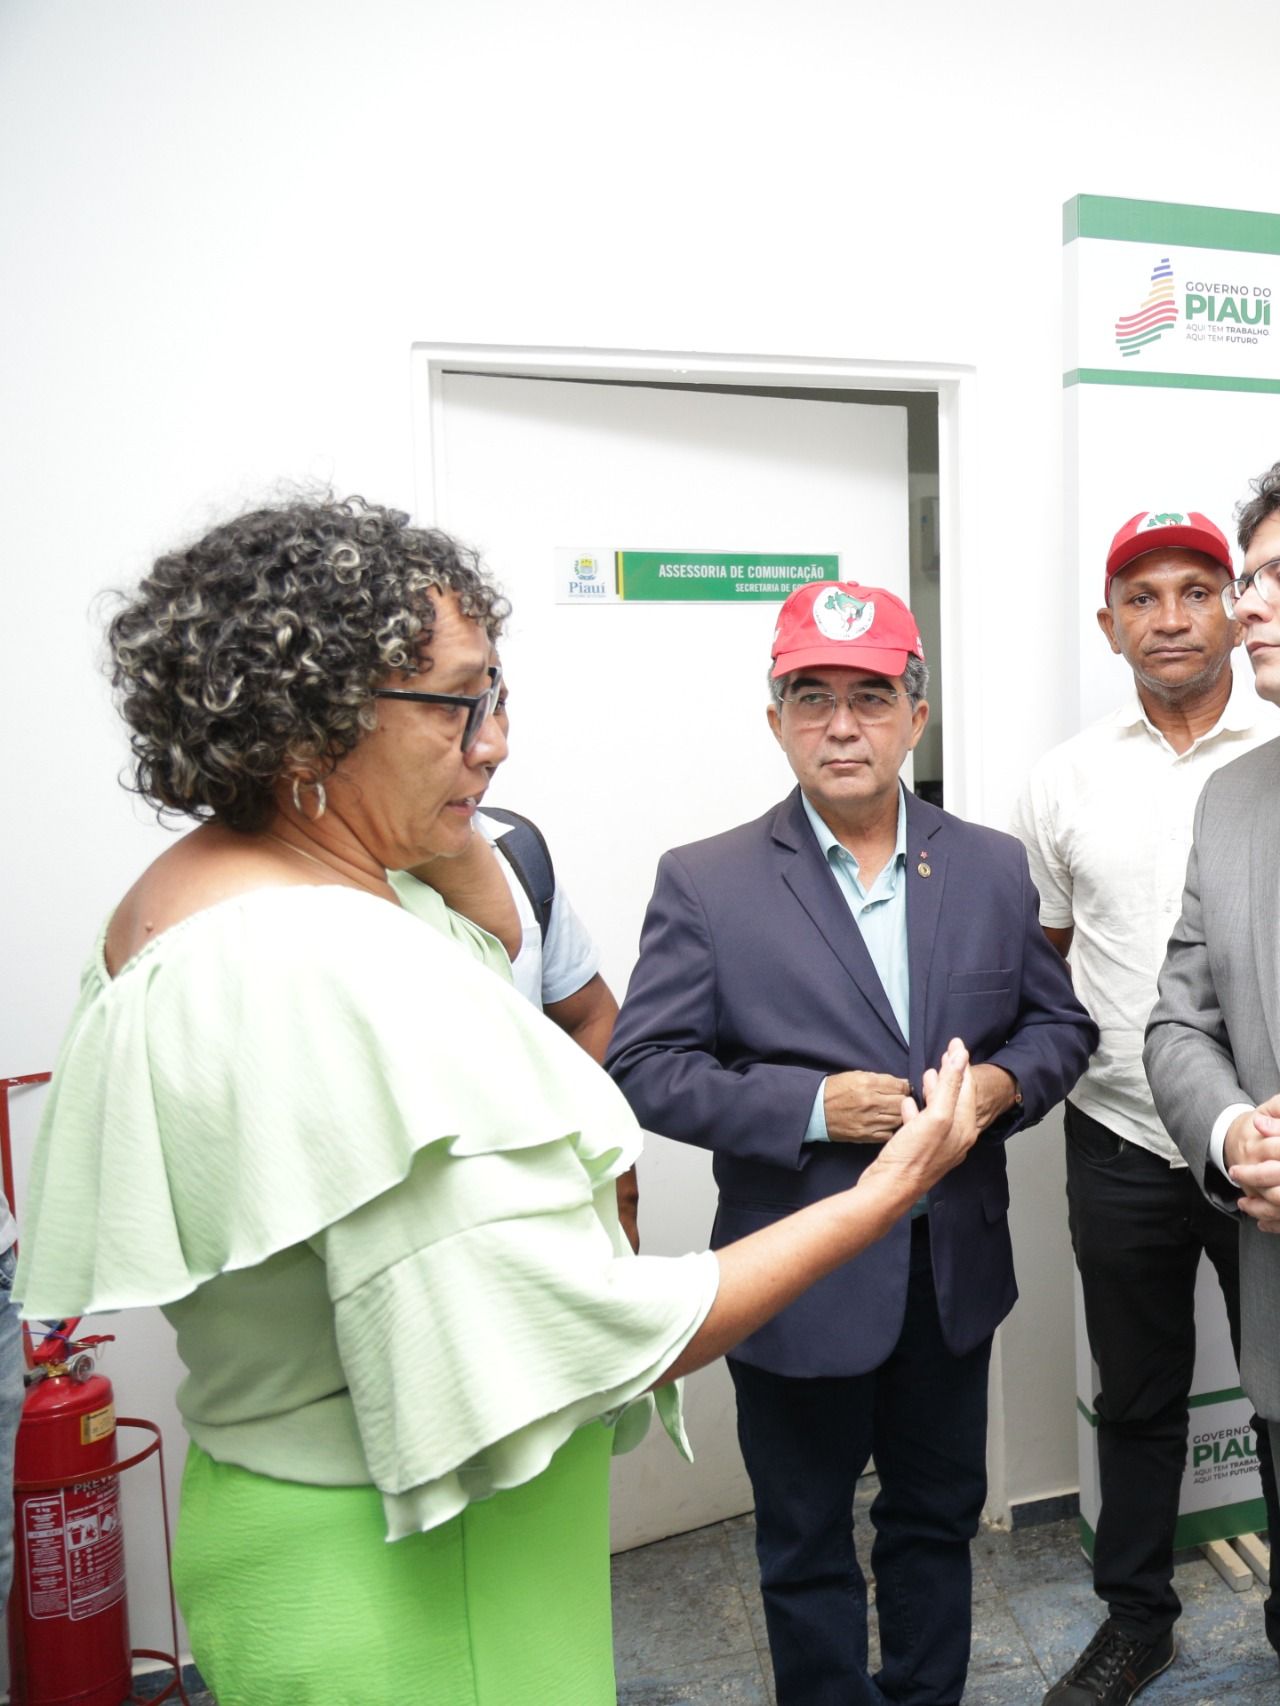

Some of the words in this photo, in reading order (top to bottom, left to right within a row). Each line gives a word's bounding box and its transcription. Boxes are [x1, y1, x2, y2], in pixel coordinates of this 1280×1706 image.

[1185, 281, 1249, 296] GOVERNO
[1253, 287, 1272, 298] DO
[1185, 293, 1271, 326] PIAUÍ
[1186, 324, 1206, 332] AQUI
[1186, 333, 1206, 341] AQUI
[1208, 334, 1224, 342] TEM
[658, 564, 727, 578] ASSESSORIA
[730, 565, 744, 578] DE
[747, 564, 824, 582] COMUNICAÇÃO
[568, 581, 606, 594] Piauí
[735, 583, 779, 592] SECRETARIA
[780, 583, 791, 592] DE
[1193, 1425, 1251, 1445] GOVERNO
[1193, 1435, 1257, 1468] PIAU
[1214, 1463, 1228, 1472] TEM
[1214, 1471, 1228, 1480] TEM
